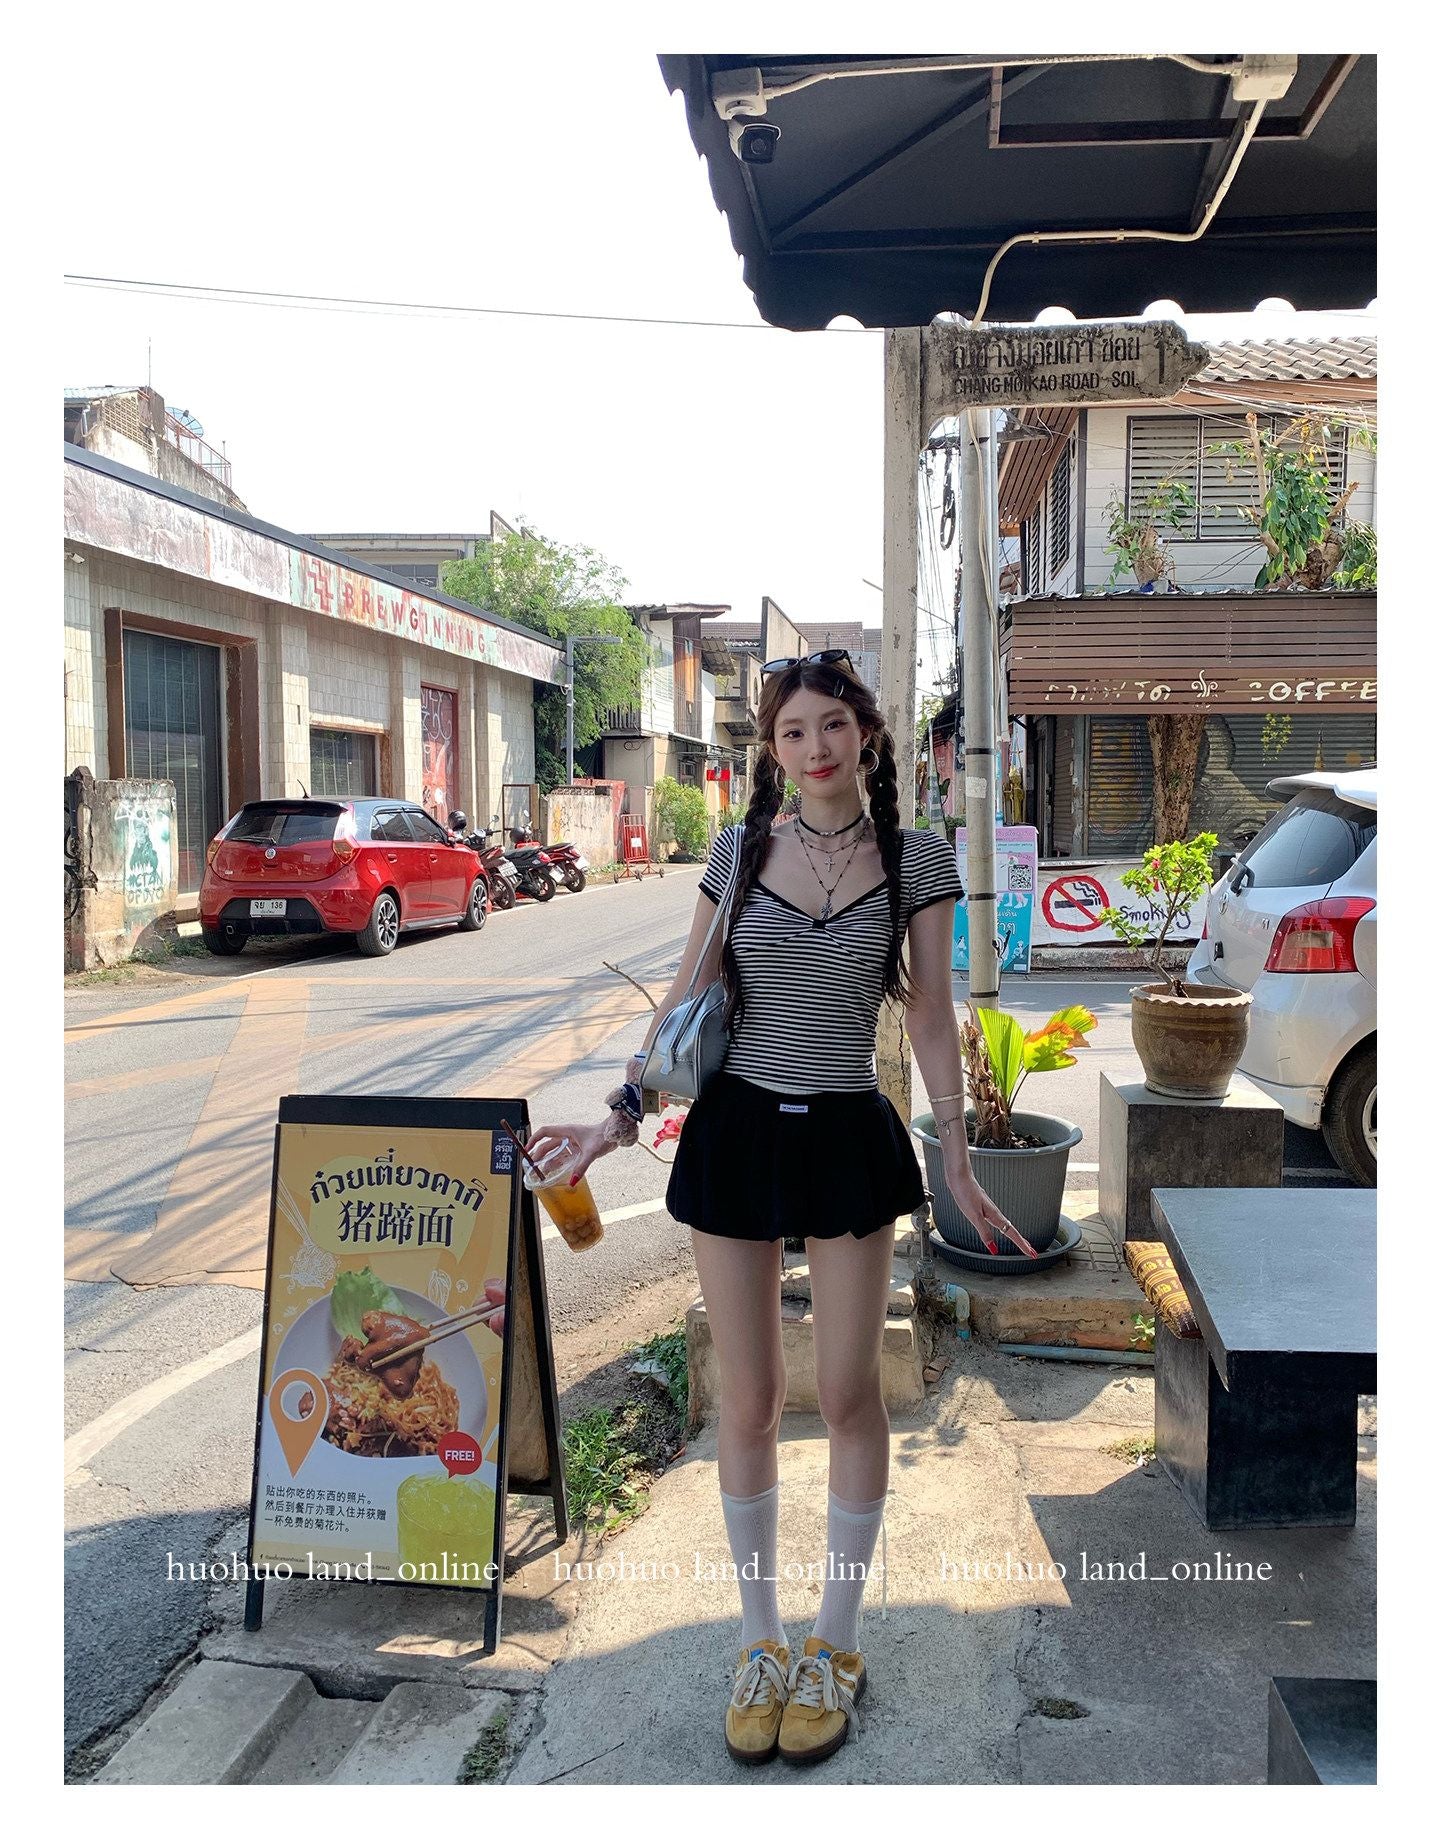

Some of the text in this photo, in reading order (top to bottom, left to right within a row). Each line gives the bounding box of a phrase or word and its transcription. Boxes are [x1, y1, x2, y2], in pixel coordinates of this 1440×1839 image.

[954, 376, 1001, 395] CHANG
[1060, 372, 1100, 390] ROAD
[342, 581, 487, 654] BREWGINNING
[1119, 905, 1191, 930] Smokig
[309, 1147, 489, 1212] ก๋วยเตี๋ยวคากิ
[337, 1200, 456, 1247] 猪蹄面
[445, 1449, 475, 1462] FREE!
[265, 1484, 372, 1506] 贴出你吃的东西的照片。
[264, 1499, 387, 1521] 然后到餐厅办理入住并获赠
[264, 1514, 351, 1533] 一杯免费的菊花汁。
